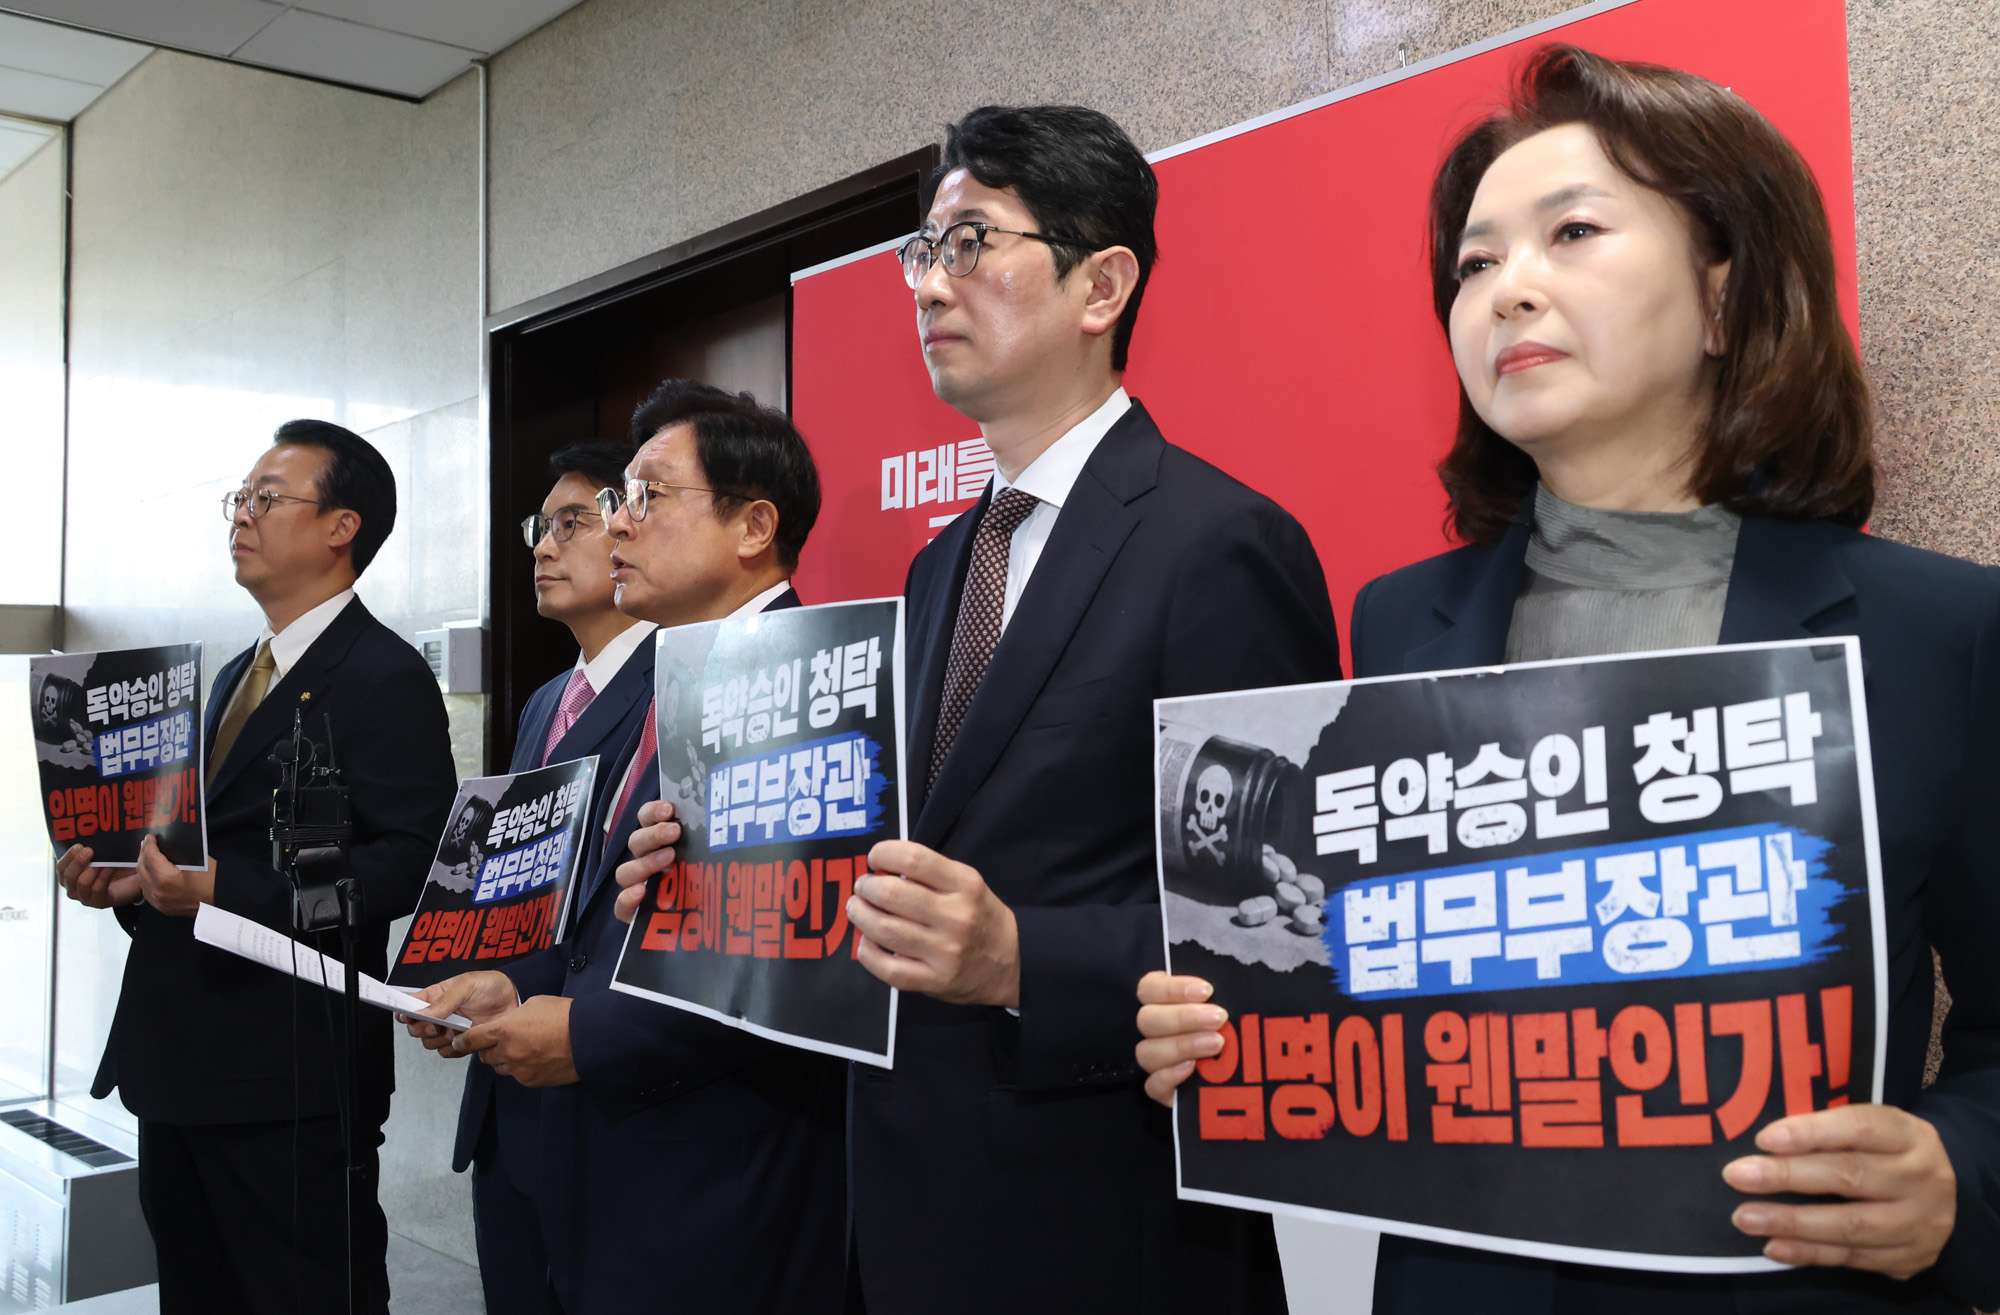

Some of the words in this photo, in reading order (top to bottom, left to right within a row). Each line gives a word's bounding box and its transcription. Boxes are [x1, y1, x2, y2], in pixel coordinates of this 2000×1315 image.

[881, 437, 994, 511] 미래를
[86, 671, 164, 725] 독약승인
[166, 660, 197, 707] 청탁
[700, 658, 802, 754] 독약승인
[808, 636, 882, 730] 청탁
[100, 711, 191, 777] 법무부장관
[1312, 726, 1609, 864] 독약승인
[1632, 691, 1822, 824] 청탁
[50, 782, 120, 841] 임명이
[486, 791, 555, 849] 독약승인
[550, 776, 586, 828] 청탁
[708, 738, 871, 848] 법무부장관
[475, 830, 571, 901] 법무부장관
[401, 908, 485, 964] 임명이
[640, 861, 723, 953] 임명이
[1343, 832, 1808, 994] 법무부장관
[1195, 1012, 1409, 1142] 임명이
[1423, 984, 1853, 1148] 웬말인가!
